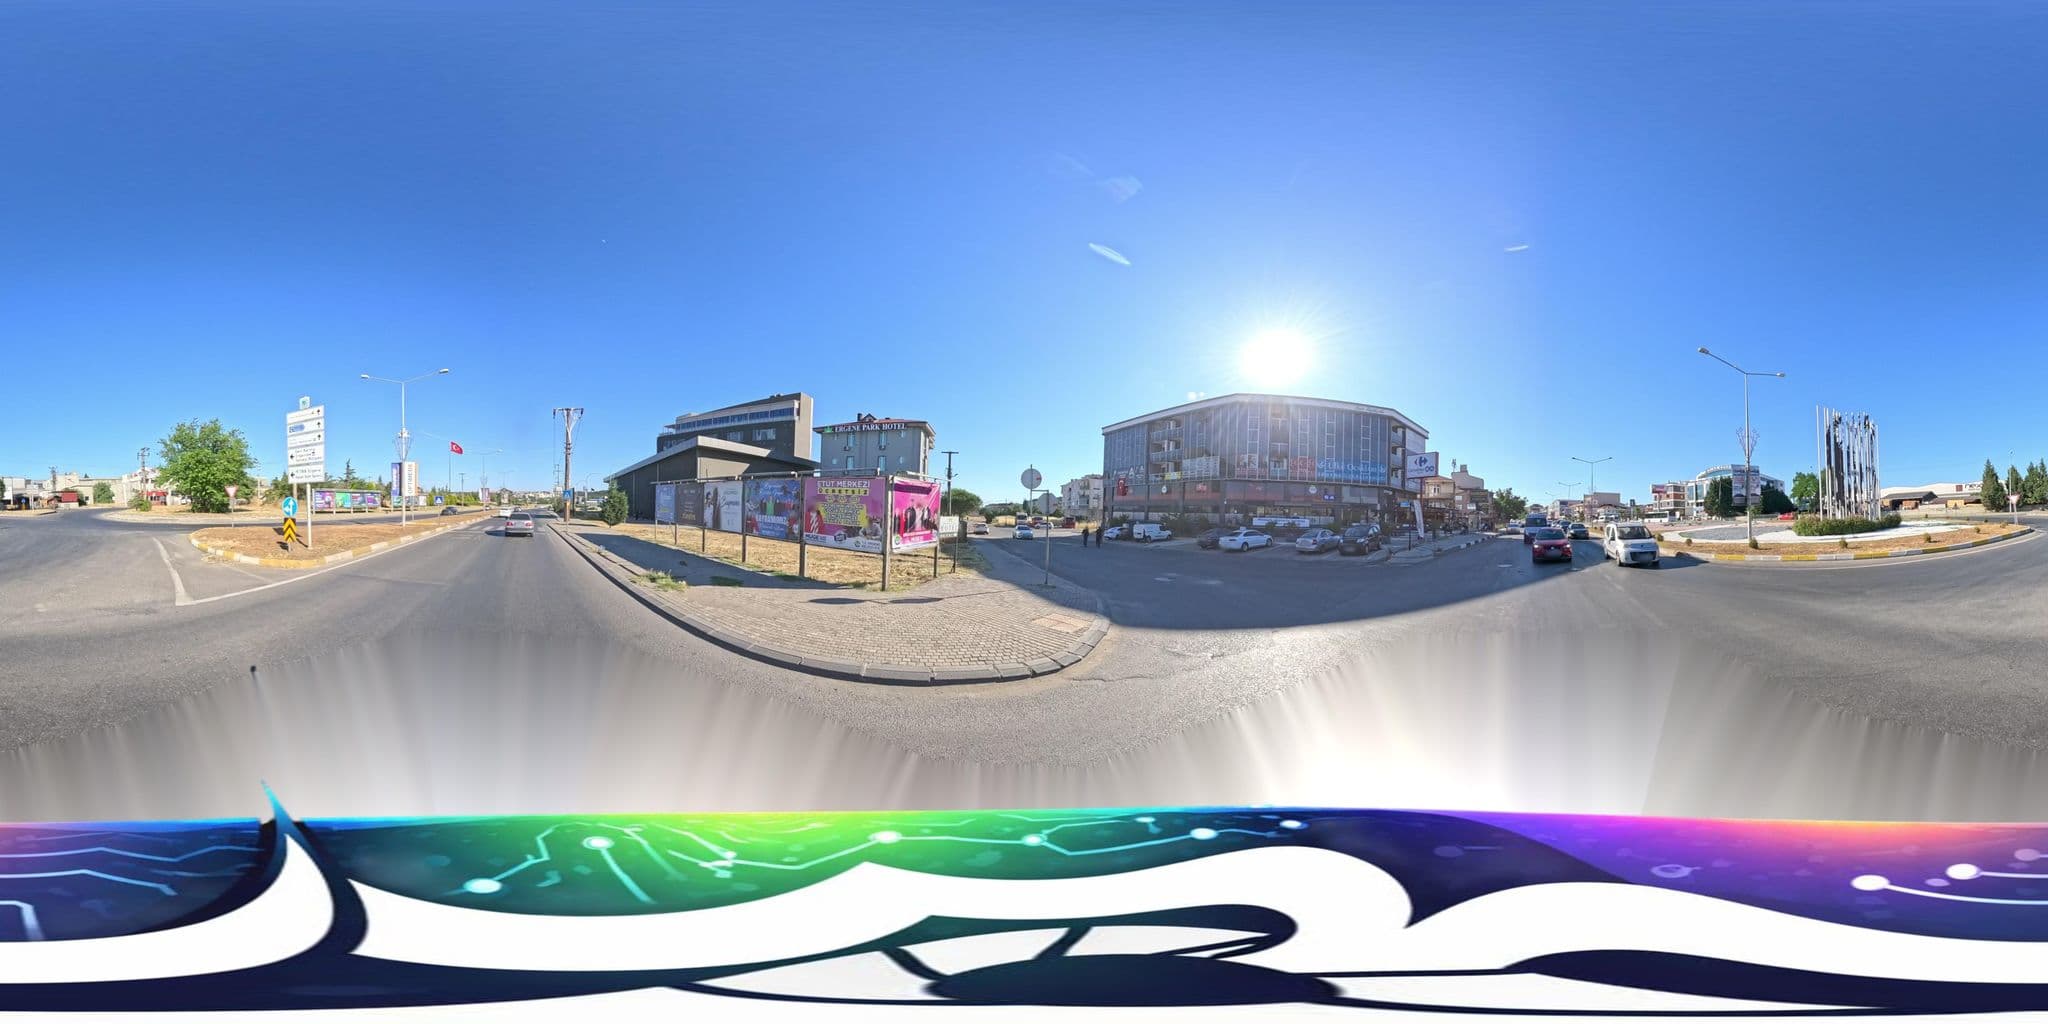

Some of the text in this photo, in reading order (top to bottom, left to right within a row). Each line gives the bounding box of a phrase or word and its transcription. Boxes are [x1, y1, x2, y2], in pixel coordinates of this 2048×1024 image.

[834, 418, 906, 433] ERGENE PARK HOTEL
